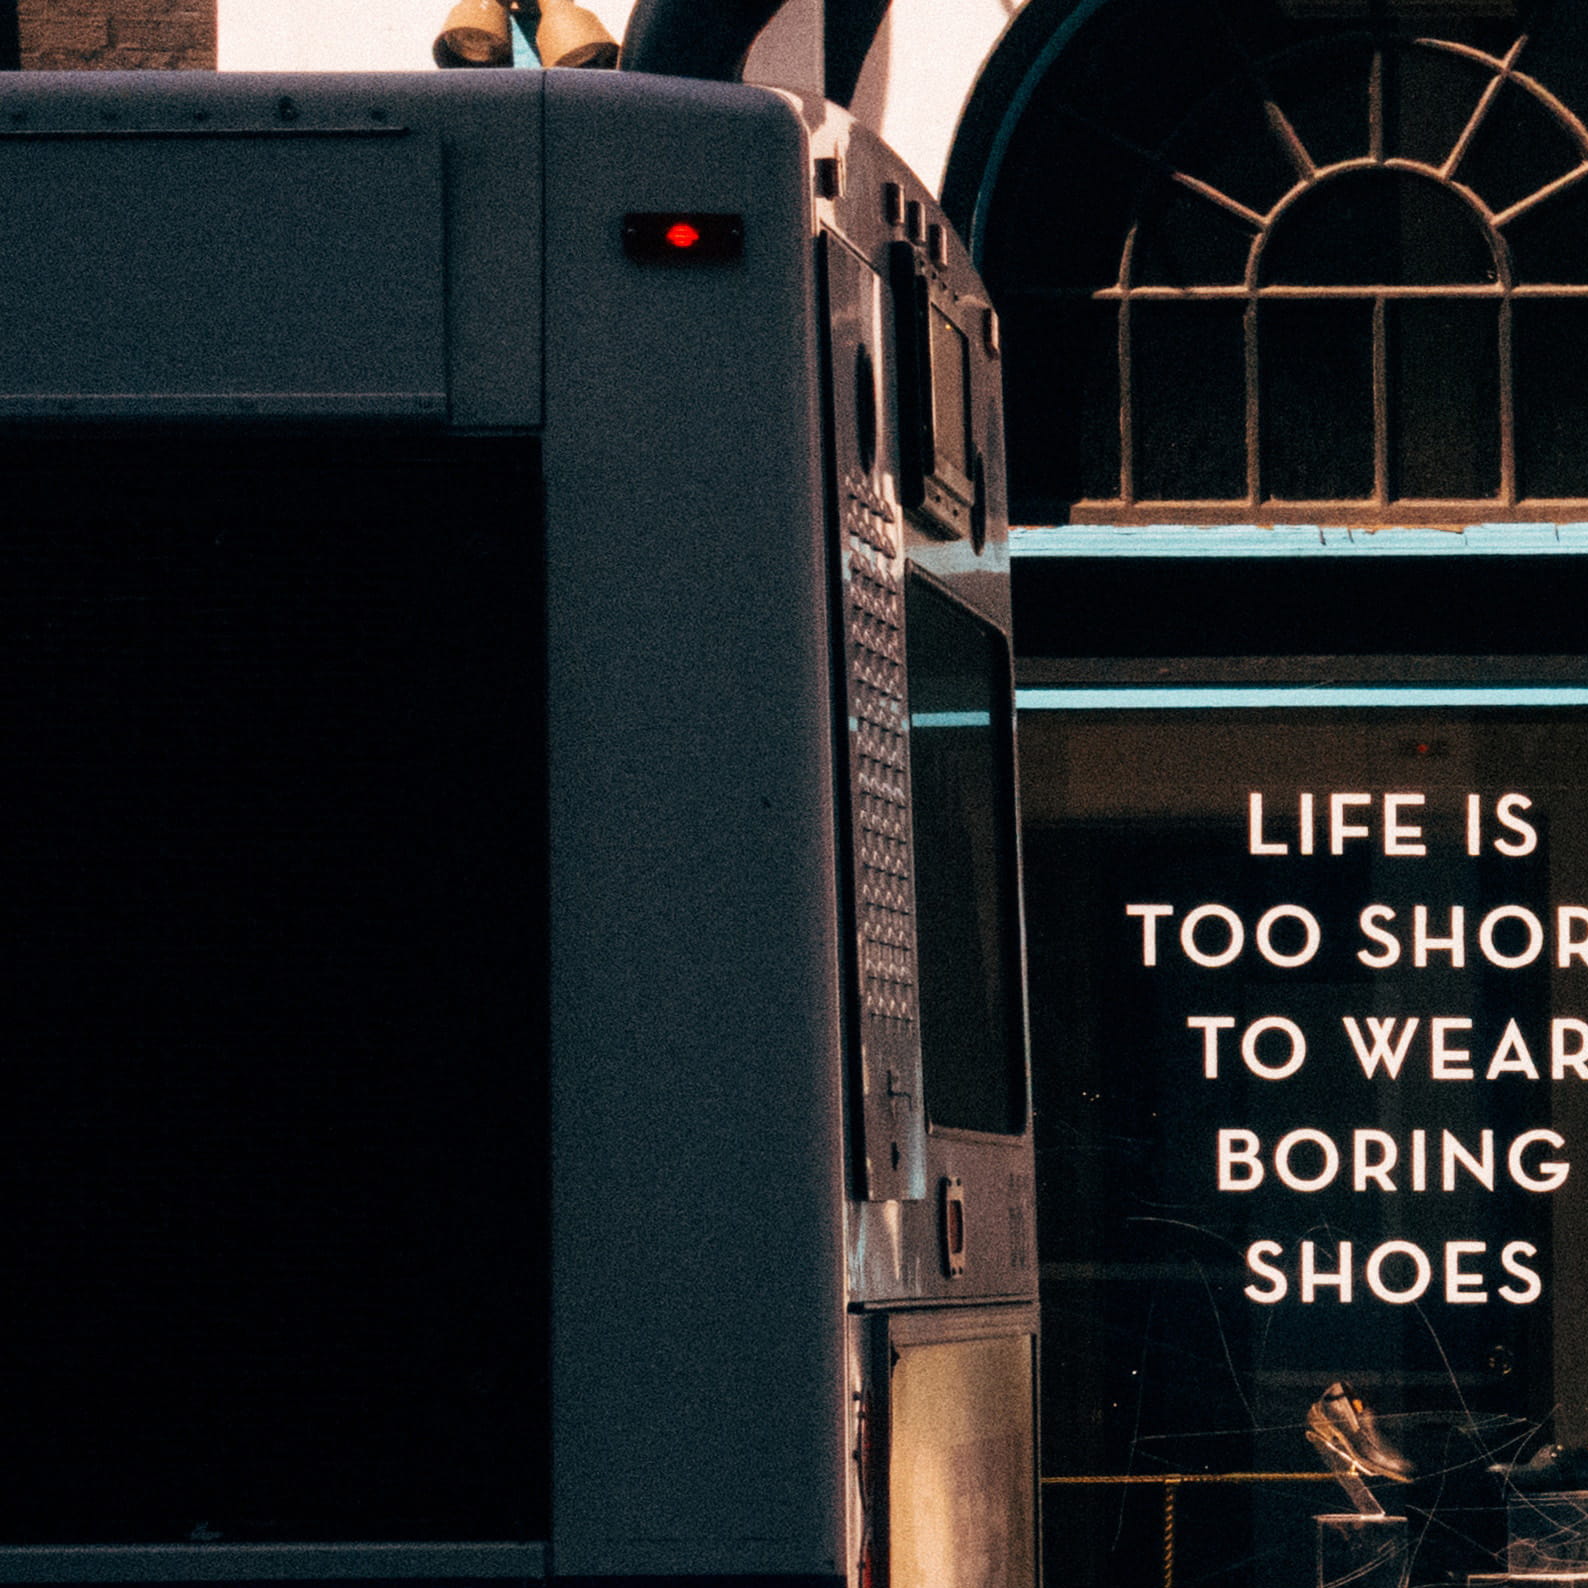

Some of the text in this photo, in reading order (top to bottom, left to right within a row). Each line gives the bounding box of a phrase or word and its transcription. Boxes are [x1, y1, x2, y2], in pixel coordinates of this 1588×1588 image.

[1250, 792, 1537, 857] LIFE IS
[1126, 904, 1321, 968] TOO
[1188, 1016, 1306, 1080] TO
[1218, 1128, 1570, 1192] BORING
[1244, 1240, 1541, 1304] SHOES
